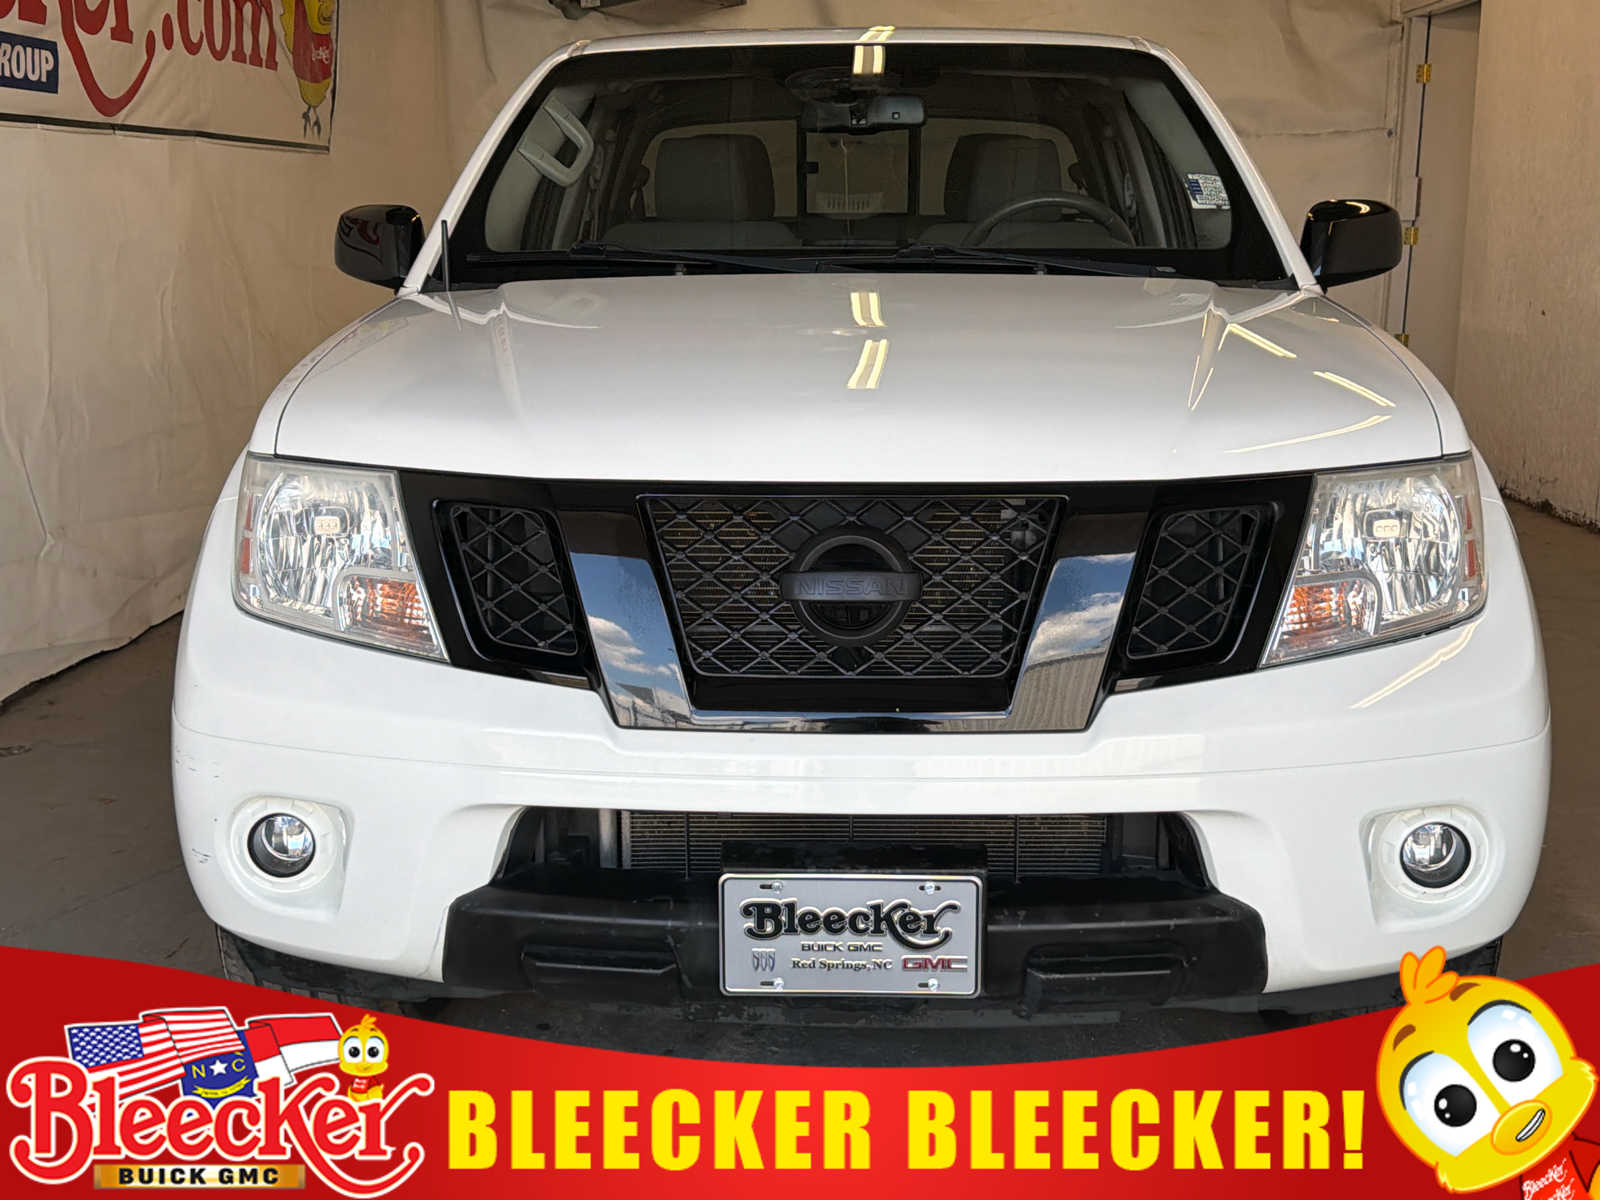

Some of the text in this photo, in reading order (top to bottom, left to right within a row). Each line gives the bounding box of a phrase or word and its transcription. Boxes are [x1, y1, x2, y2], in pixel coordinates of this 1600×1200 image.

[795, 576, 907, 595] NISSAN
[739, 897, 960, 950] Bleecker
[800, 941, 883, 952] BUICK GMC
[791, 957, 816, 969] Red
[872, 959, 893, 970] NC
[902, 955, 968, 972] GMC
